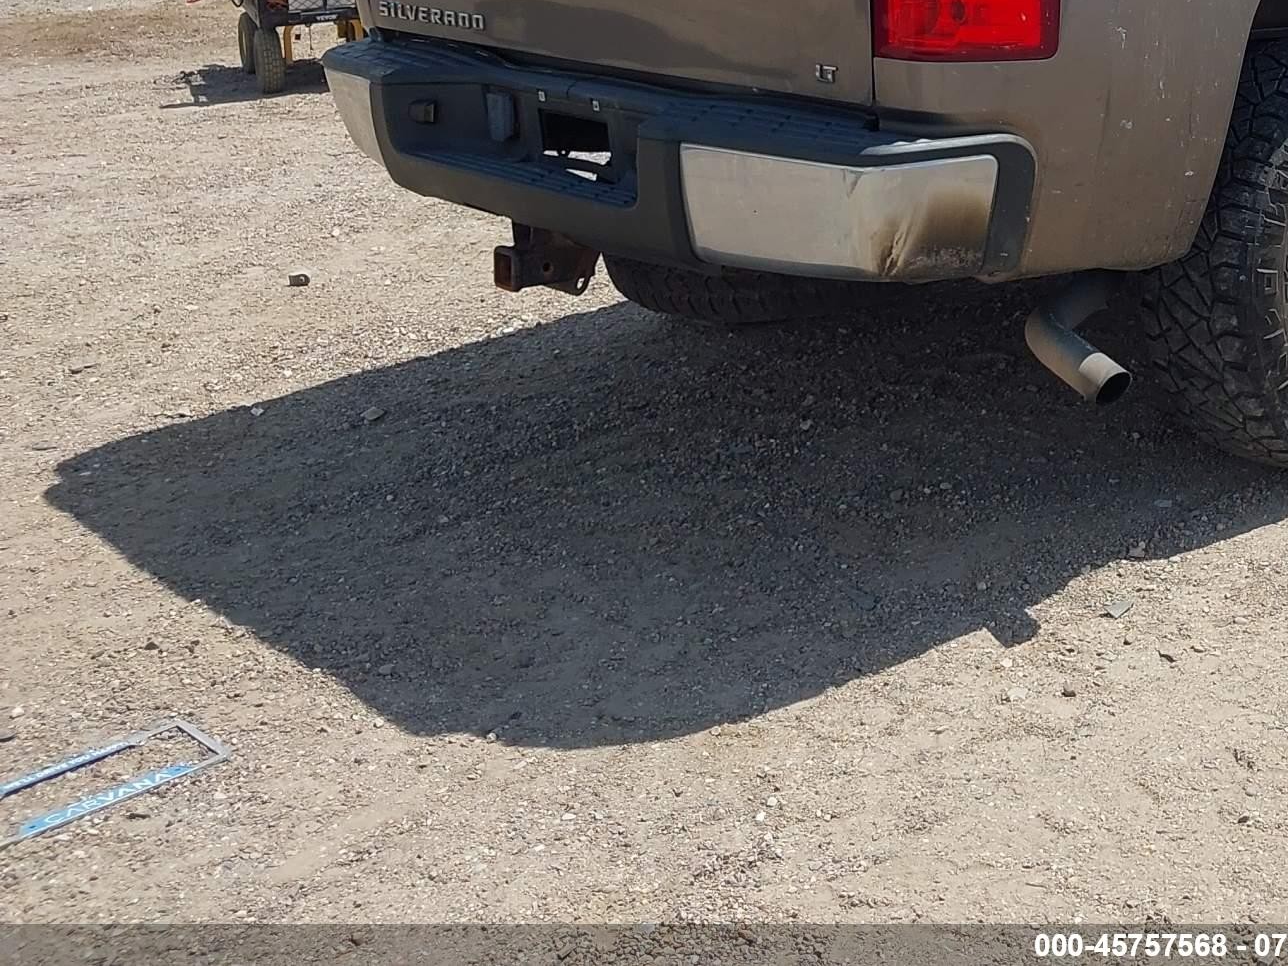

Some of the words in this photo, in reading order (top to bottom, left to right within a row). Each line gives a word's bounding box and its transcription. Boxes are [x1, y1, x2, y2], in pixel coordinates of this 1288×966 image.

[379, 0, 485, 30] SILVERADO
[815, 64, 837, 83] LT
[44, 773, 171, 823] CARVANA
